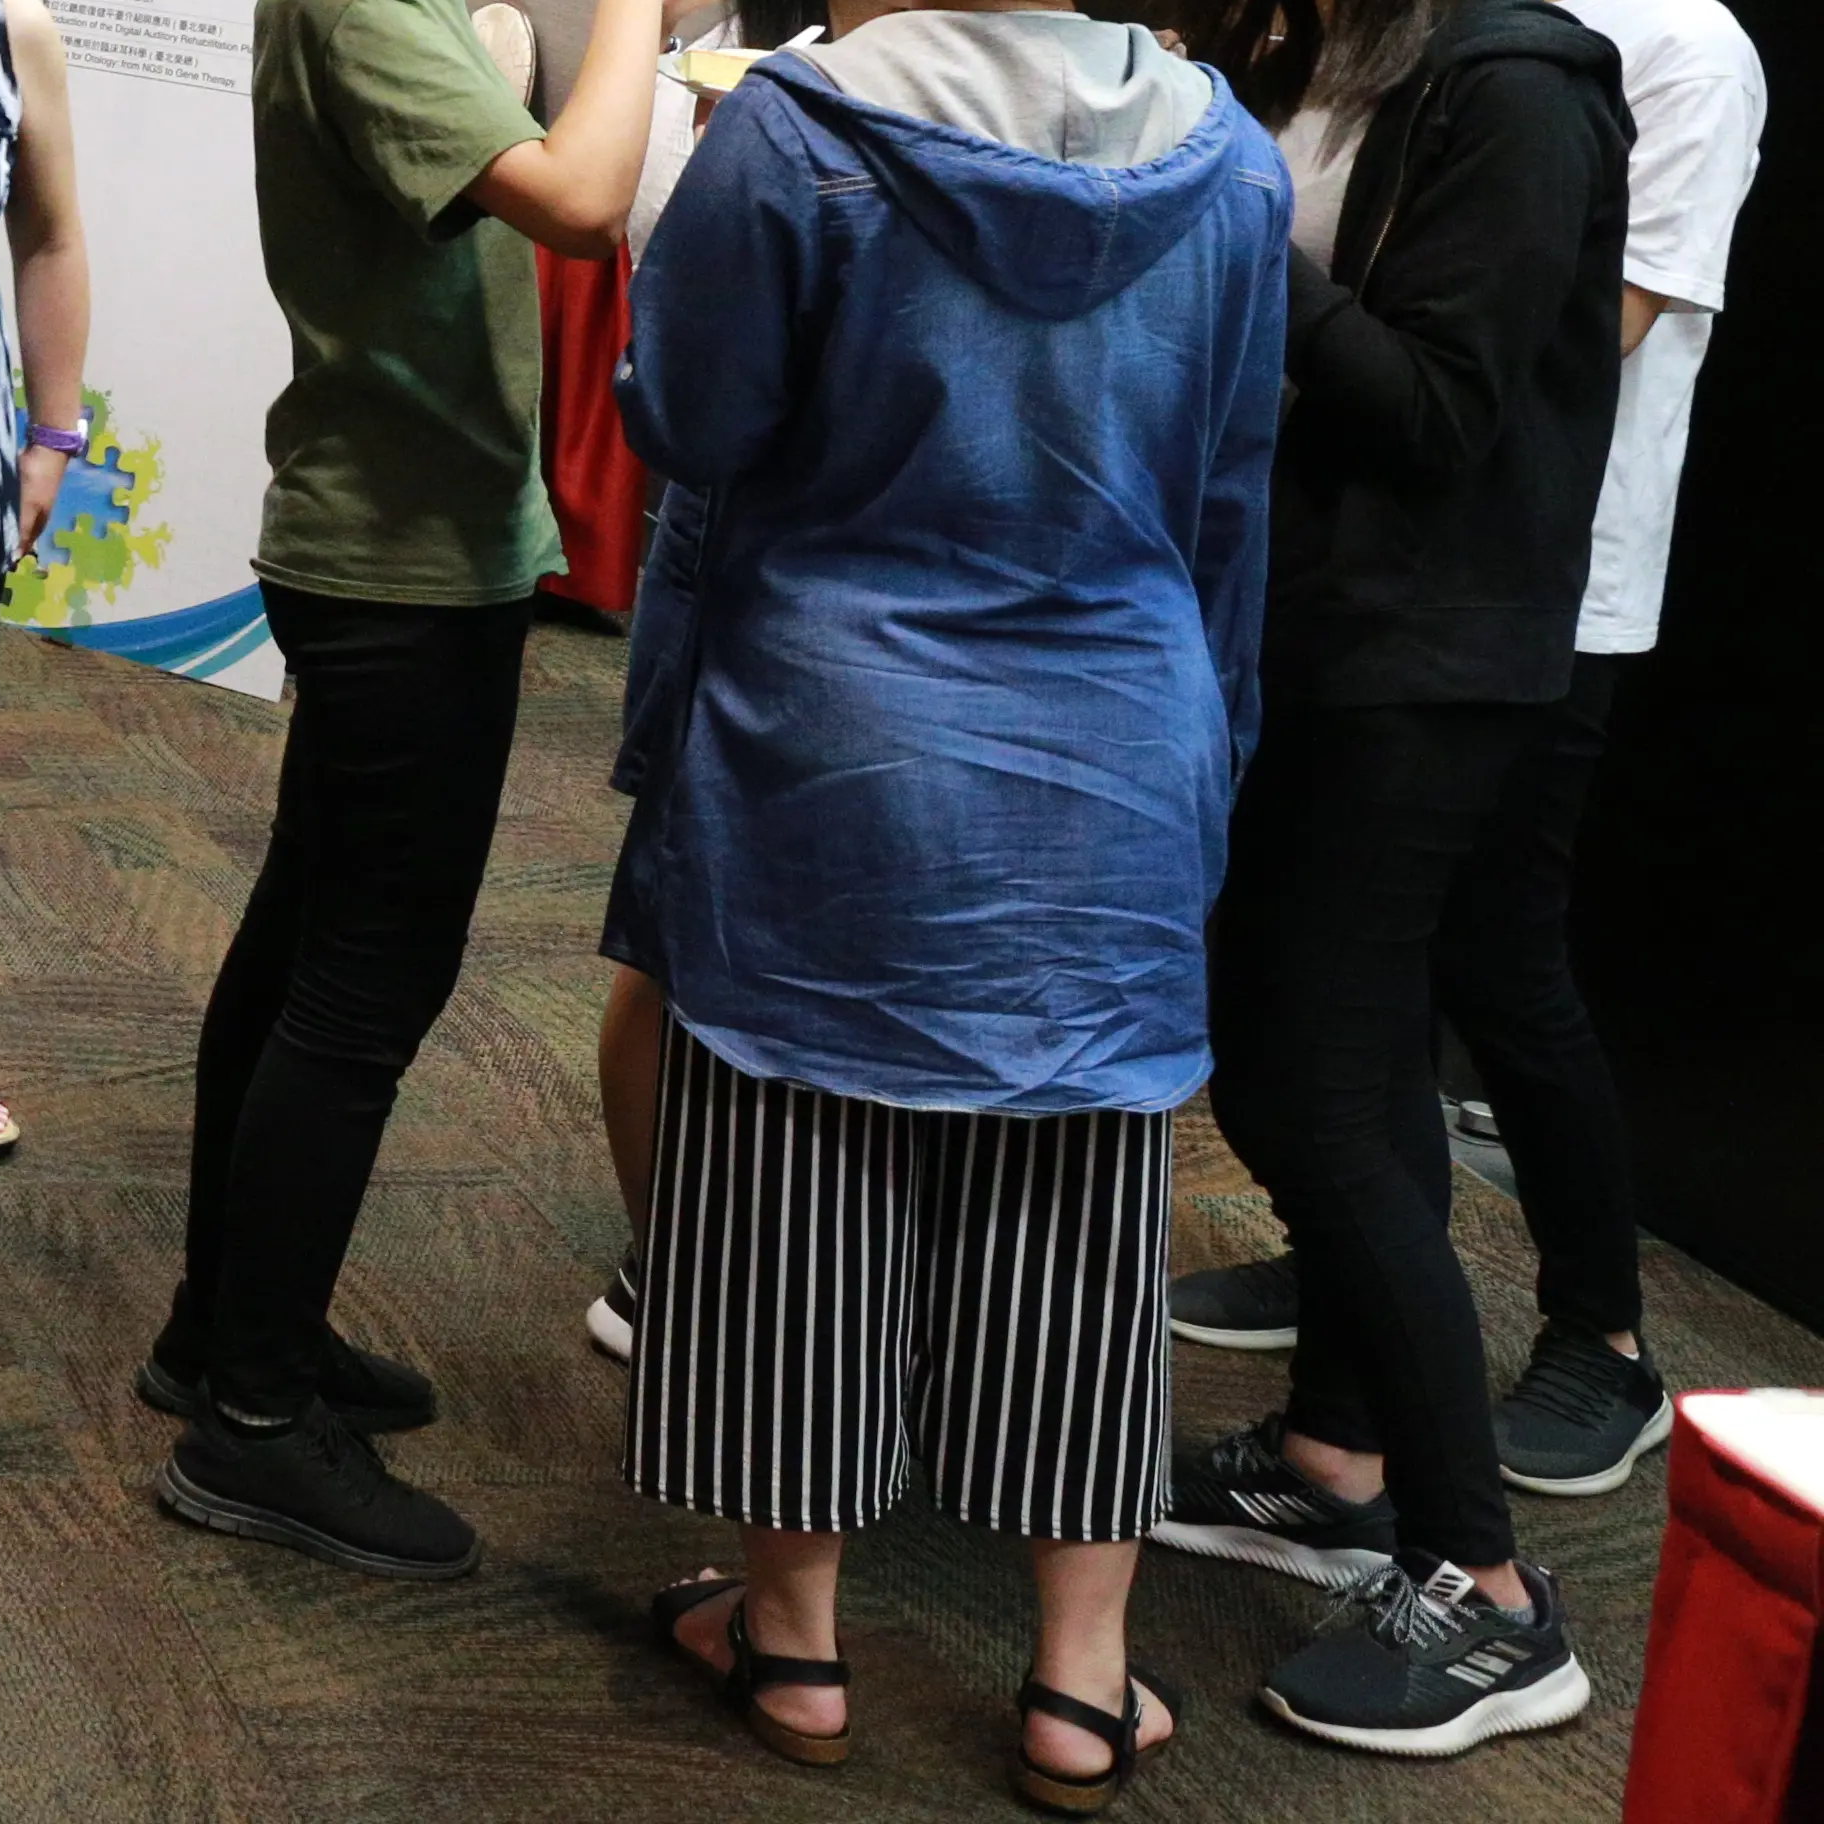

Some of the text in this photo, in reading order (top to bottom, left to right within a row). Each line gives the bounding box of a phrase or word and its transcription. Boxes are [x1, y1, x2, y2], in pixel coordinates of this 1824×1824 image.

[89, 20, 97, 29] of
[99, 22, 112, 31] the
[115, 24, 141, 38] Digital
[143, 28, 177, 43] Auditory
[180, 34, 238, 51] Rehabilitation
[71, 52, 81, 60] for
[121, 60, 139, 70] from
[142, 63, 162, 73] NGS
[175, 69, 198, 79] Gene
[201, 73, 235, 88] Therapy
